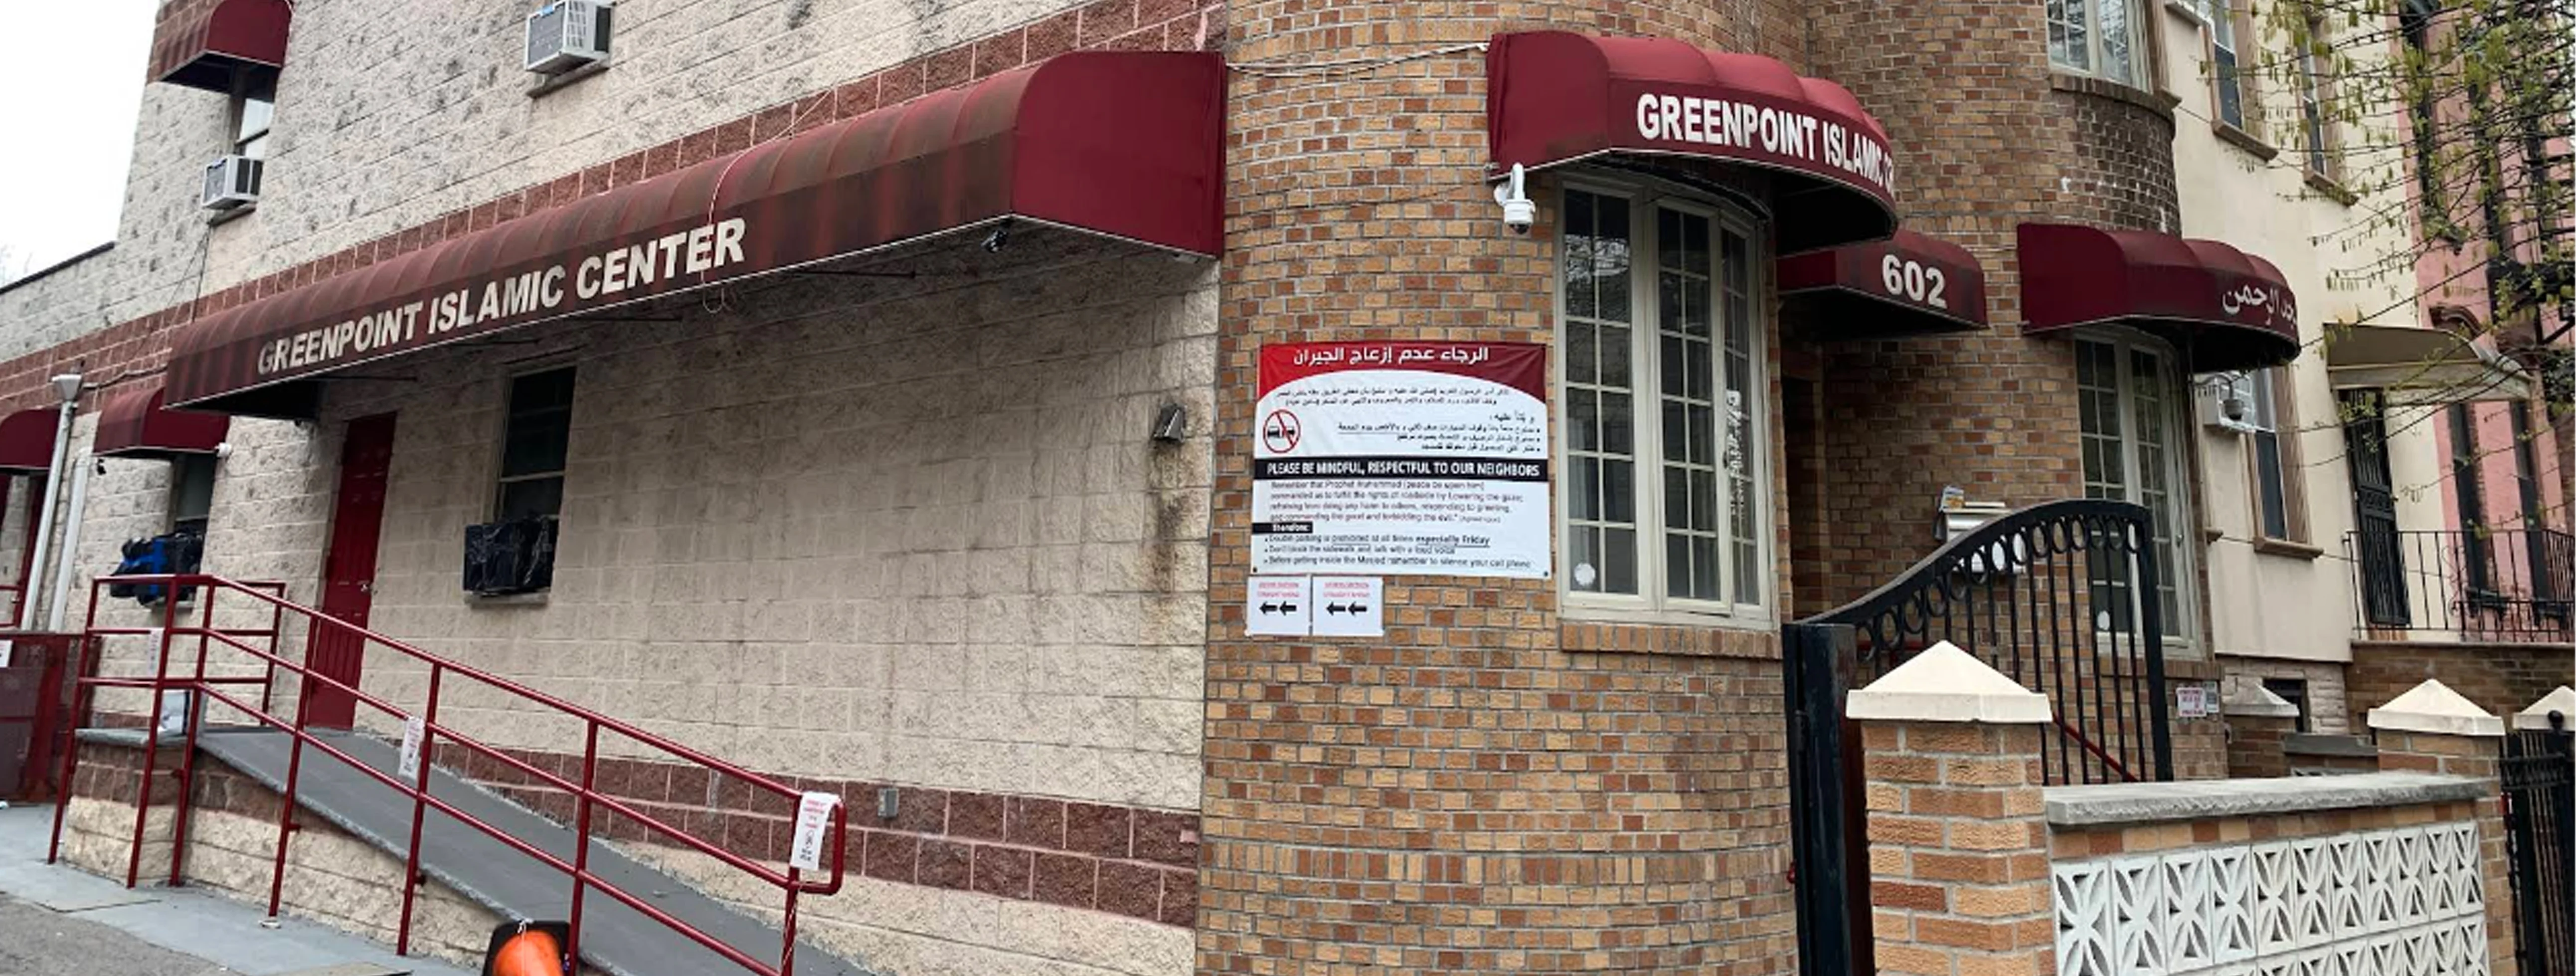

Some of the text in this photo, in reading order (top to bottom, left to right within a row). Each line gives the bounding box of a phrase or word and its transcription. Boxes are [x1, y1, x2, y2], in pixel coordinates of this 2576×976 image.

[1637, 93, 1817, 160] GREENPOINT
[1822, 121, 1883, 188] ISLAMIC
[258, 217, 746, 375] GREENPOINT ISLAMIC CENTER
[1882, 254, 1947, 309] 602
[2222, 284, 2280, 326] الرحمن
[1293, 346, 1489, 366] الرجاء عدم إزعاج الجيران
[1267, 461, 1540, 476] PLEASE BE MINDFUL, RESPECTFUL TO OUR NEIGHBORS
